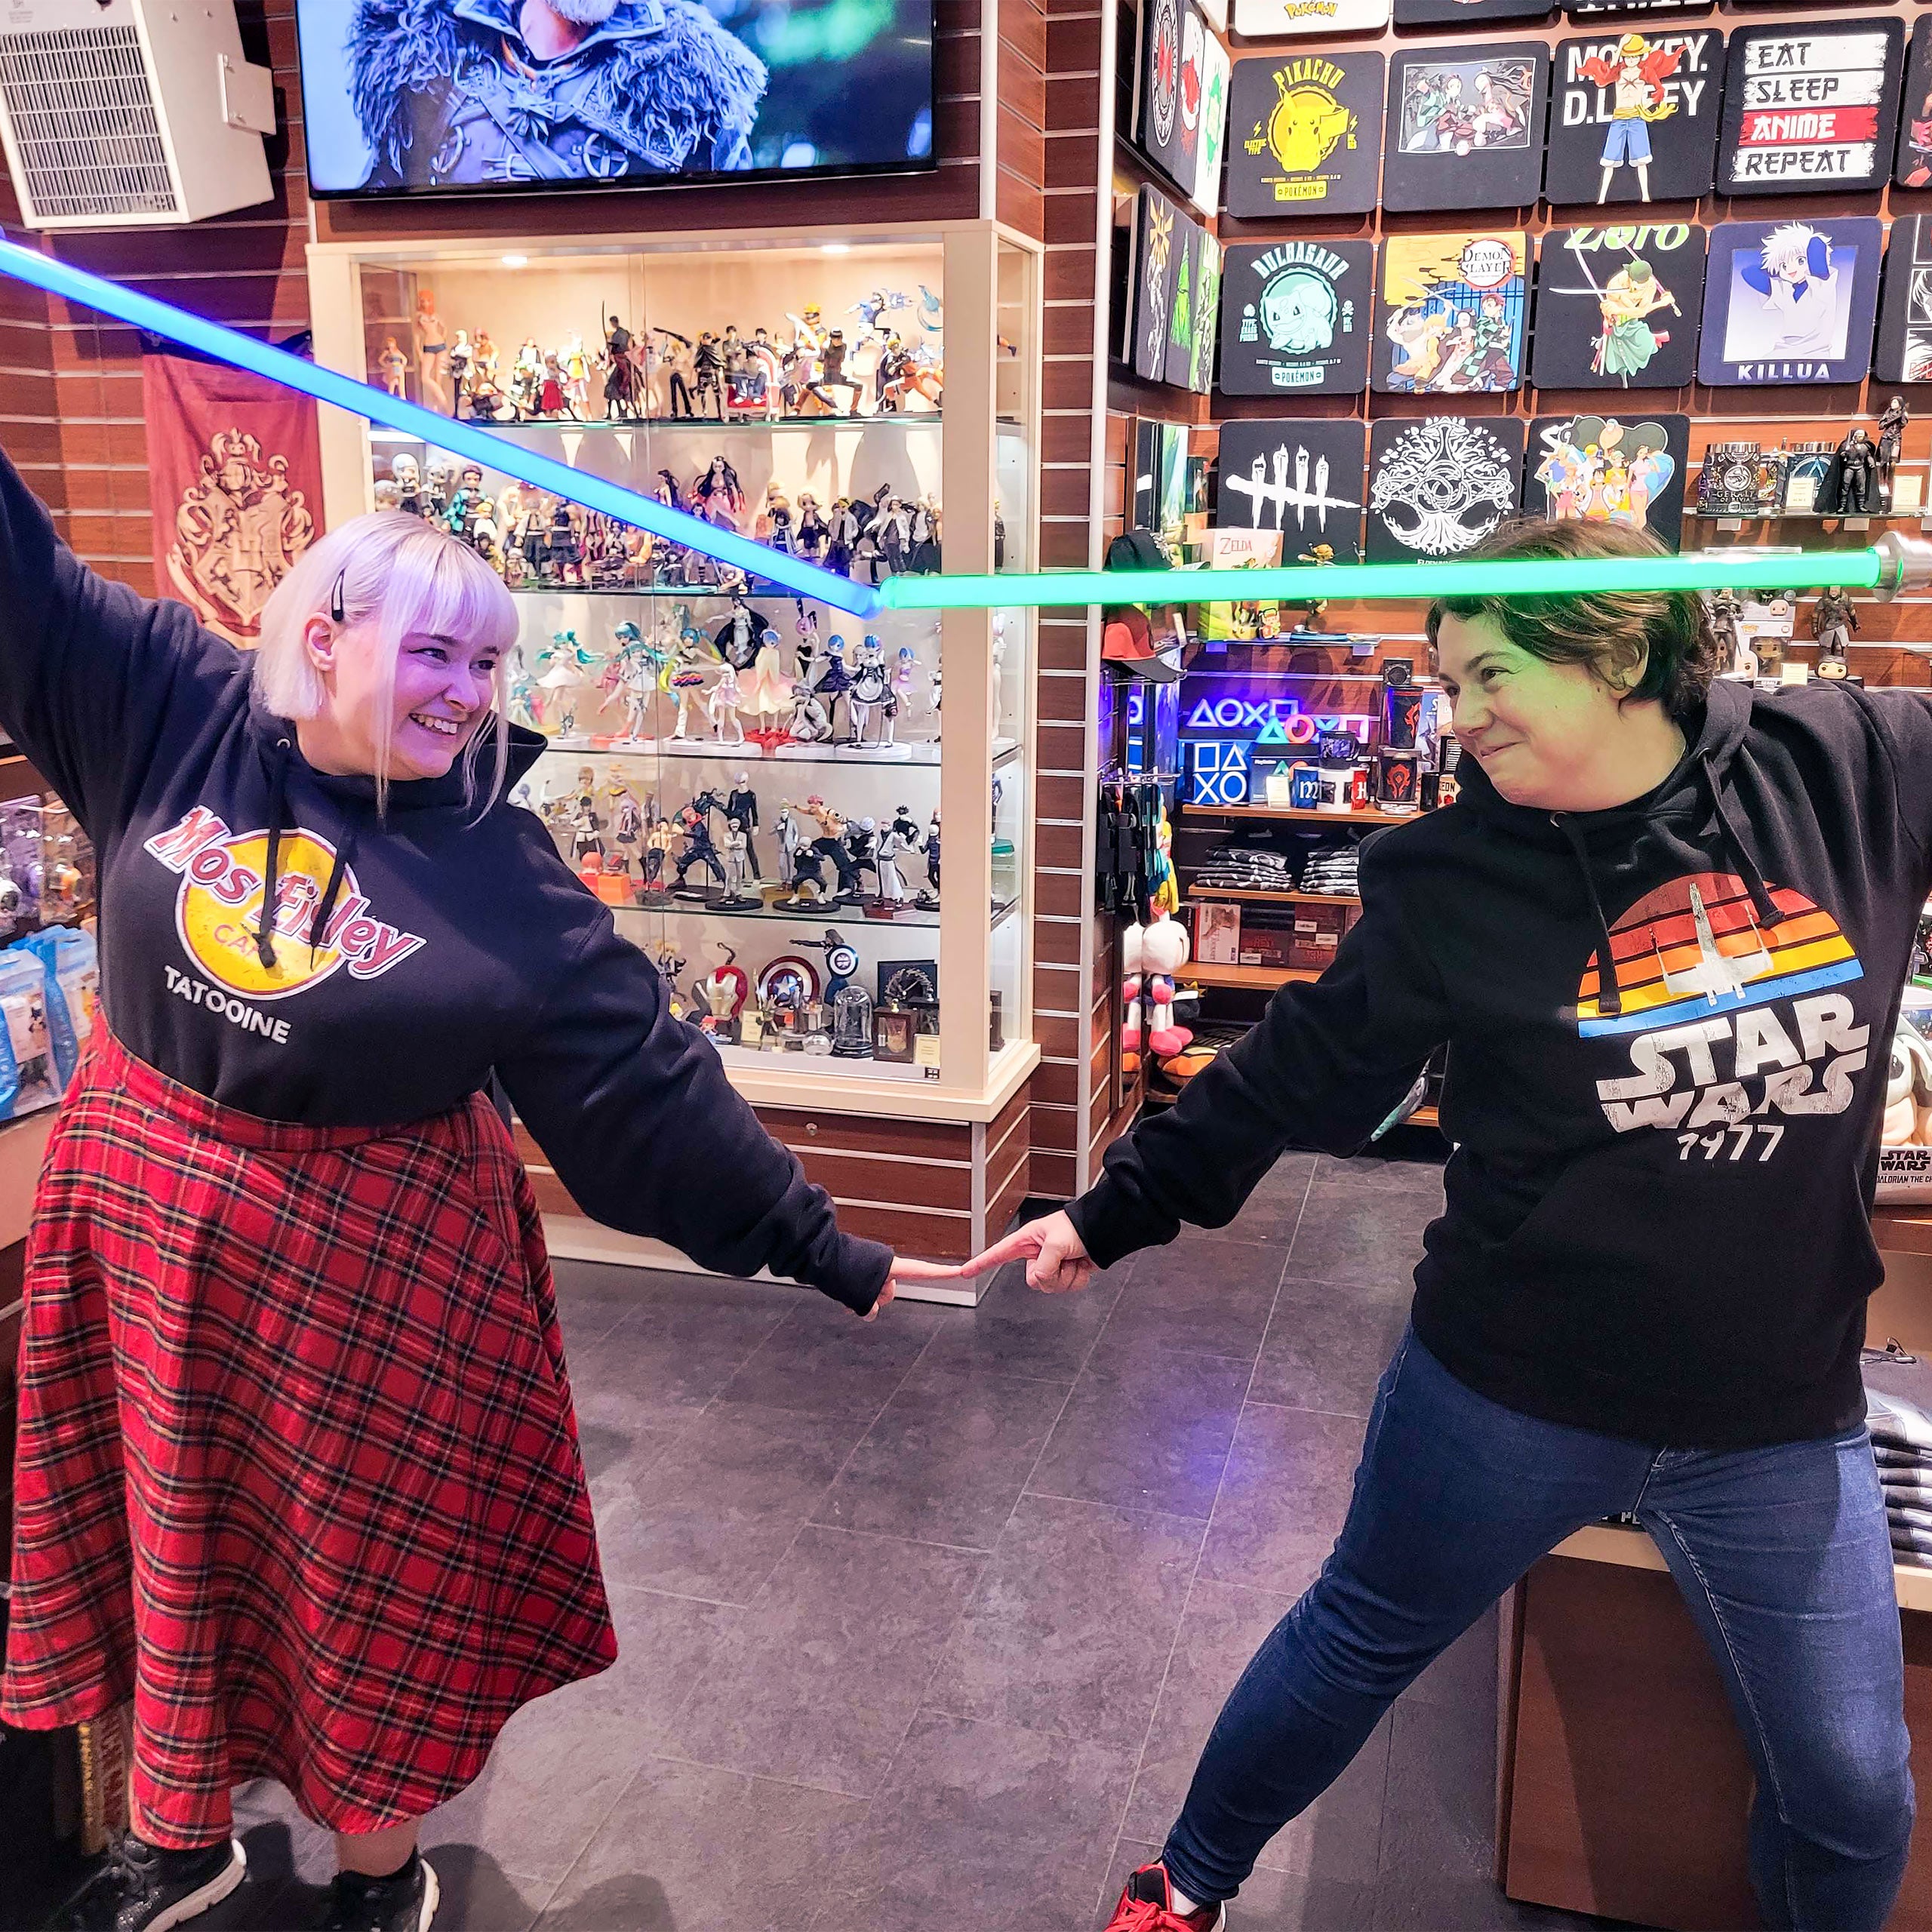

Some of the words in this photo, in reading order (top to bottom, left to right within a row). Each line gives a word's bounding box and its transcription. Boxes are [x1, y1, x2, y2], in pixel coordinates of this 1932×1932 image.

[1758, 42, 1812, 67] EAT
[1272, 58, 1346, 89] PIKACHU
[1755, 78, 1838, 104] SLEEP
[1750, 113, 1837, 141] ANIME
[1745, 149, 1851, 177] REPEAT
[1251, 241, 1349, 281] BULBASAUR
[1459, 260, 1514, 277] SLAYER
[1462, 248, 1511, 262] DEMON
[1281, 370, 1315, 383] POKÉMON
[1737, 363, 1831, 381] KILLUA
[1220, 537, 1252, 555] ZELDA
[146, 806, 260, 903] Mos
[164, 964, 292, 1044] TATOOINE
[1595, 992, 1870, 1101] STAR
[1600, 1048, 1868, 1132] WARS
[1677, 1124, 1784, 1161] 1977
[1881, 1150, 1930, 1160] STAR
[1881, 1161, 1930, 1171] WARS
